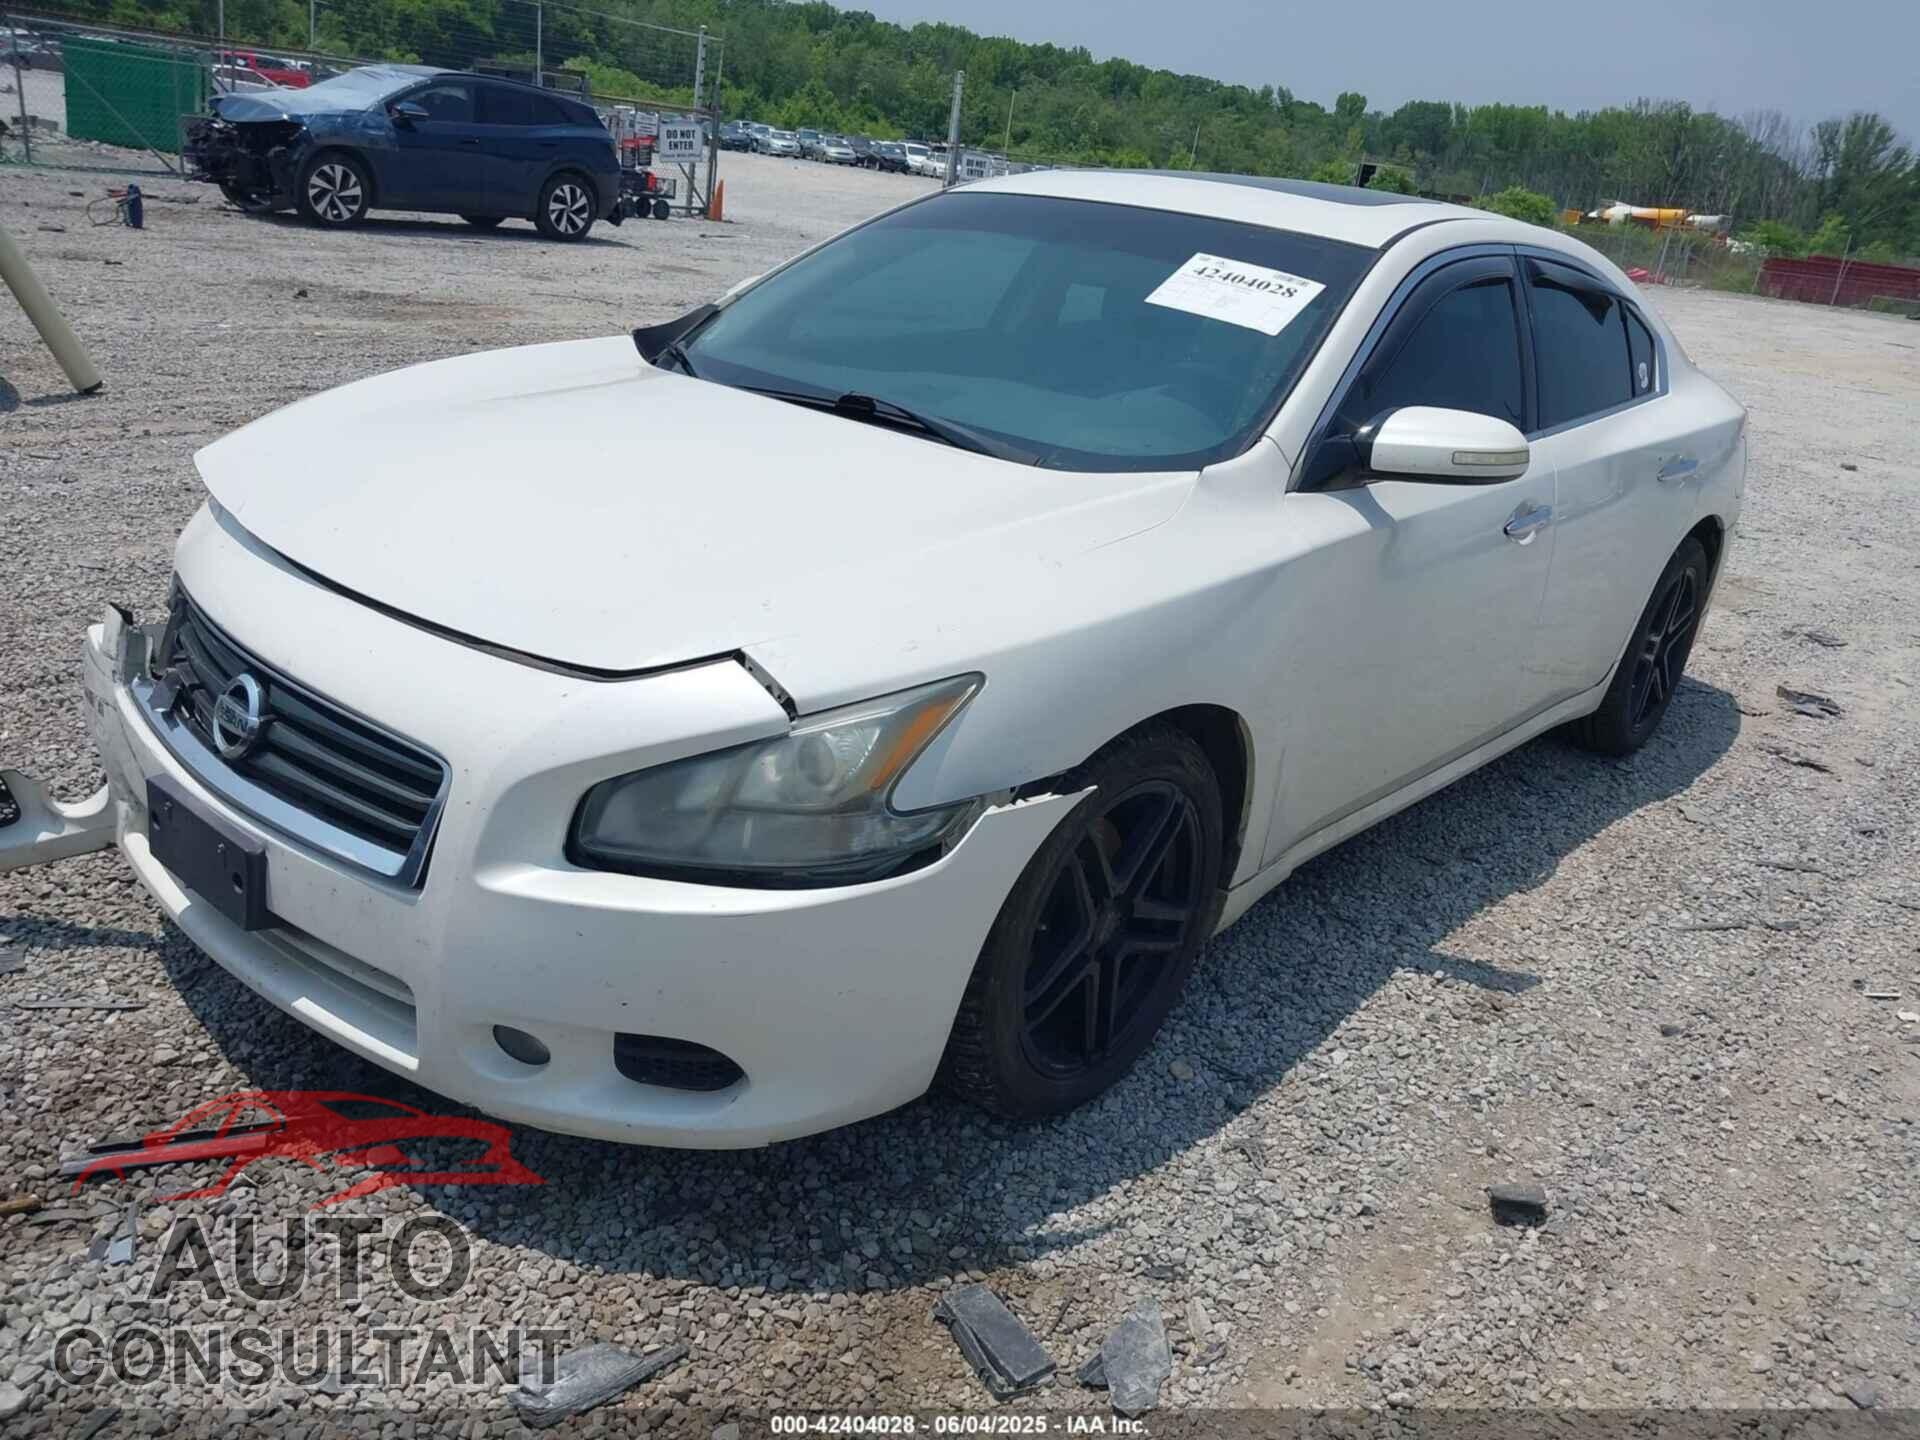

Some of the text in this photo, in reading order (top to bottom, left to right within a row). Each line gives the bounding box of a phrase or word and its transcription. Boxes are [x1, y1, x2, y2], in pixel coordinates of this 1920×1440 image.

[666, 129, 696, 139] DO NOT
[668, 140, 694, 150] ENTER
[1193, 266, 1298, 298] 42404028
